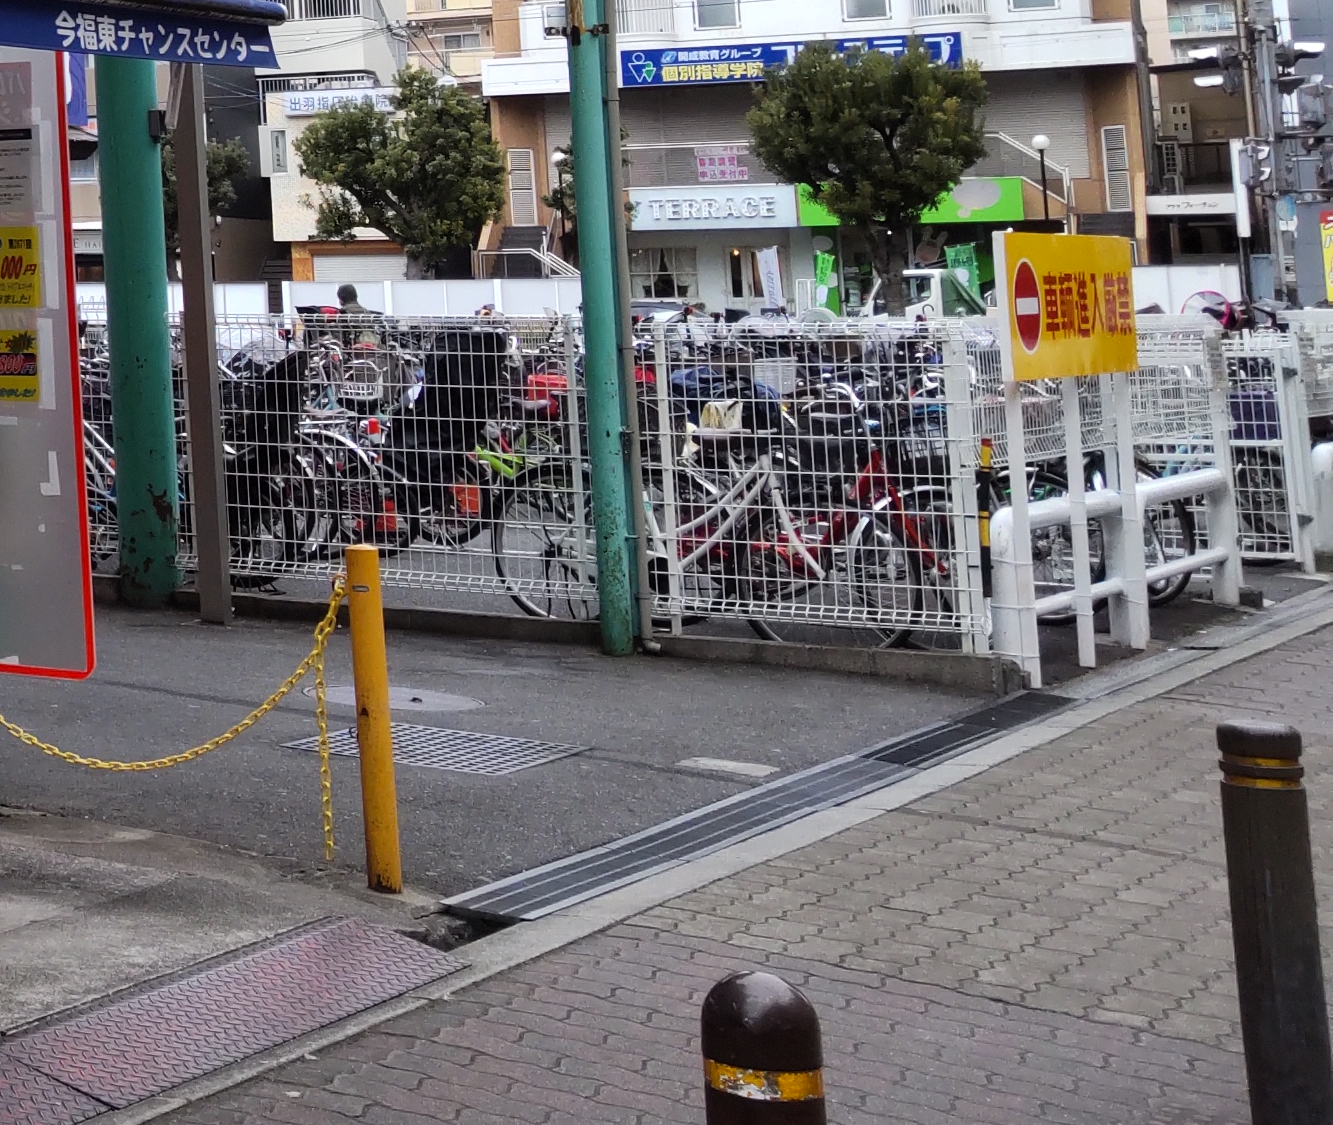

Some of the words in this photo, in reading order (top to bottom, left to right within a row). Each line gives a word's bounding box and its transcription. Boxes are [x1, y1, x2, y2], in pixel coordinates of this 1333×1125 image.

[55, 11, 270, 62] 今福東チャンスセンター
[677, 47, 763, 62] 開成教育グループ
[662, 62, 765, 82] 個別指導学院
[648, 197, 777, 220] TERRACE
